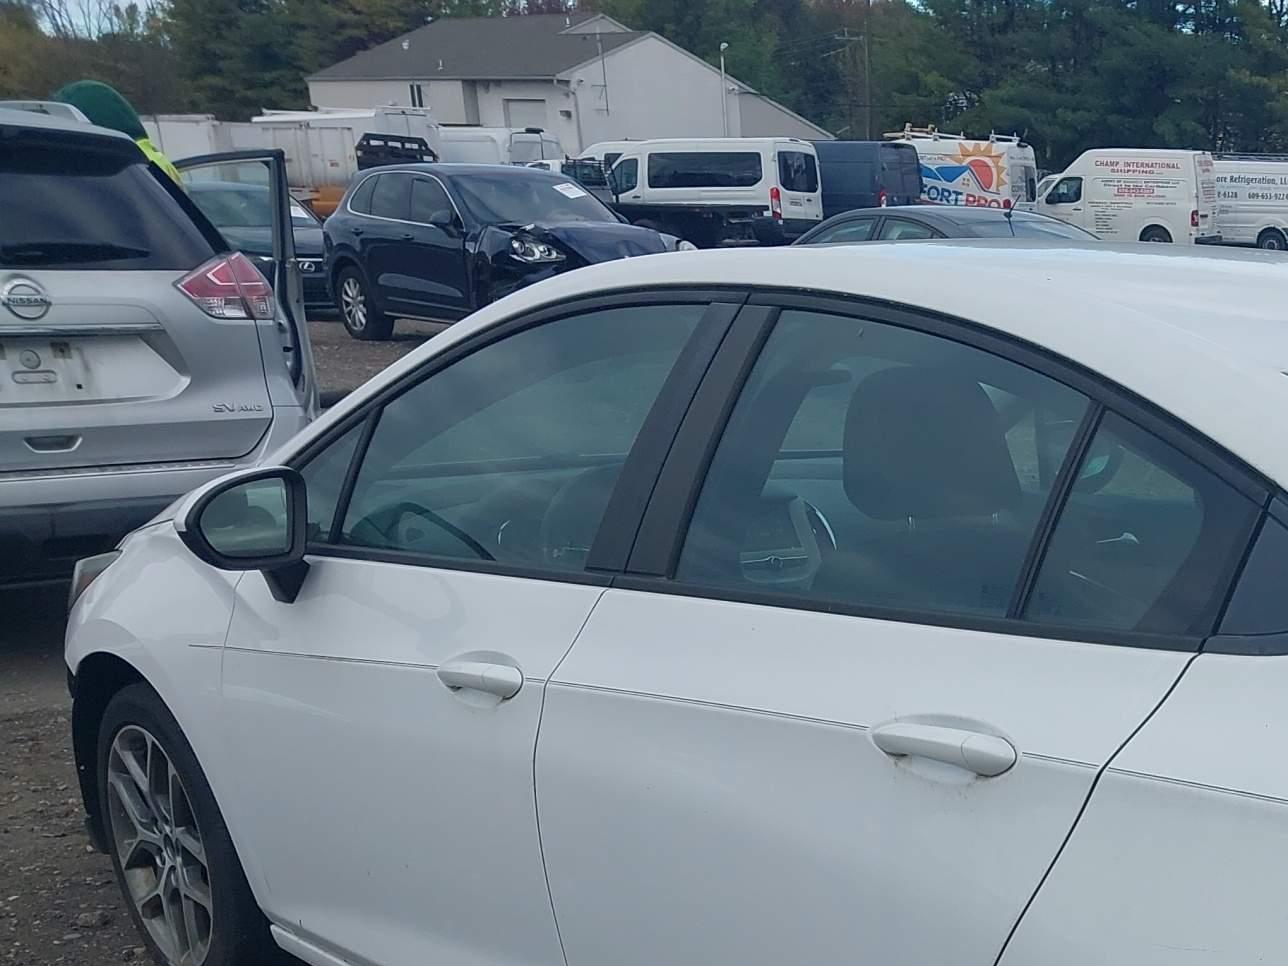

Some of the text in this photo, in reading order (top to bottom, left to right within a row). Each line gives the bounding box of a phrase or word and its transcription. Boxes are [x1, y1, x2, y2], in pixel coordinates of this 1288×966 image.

[1123, 161, 1181, 170] INTERNATIONAL
[6, 296, 49, 305] NISSAN
[212, 403, 235, 413] SV
